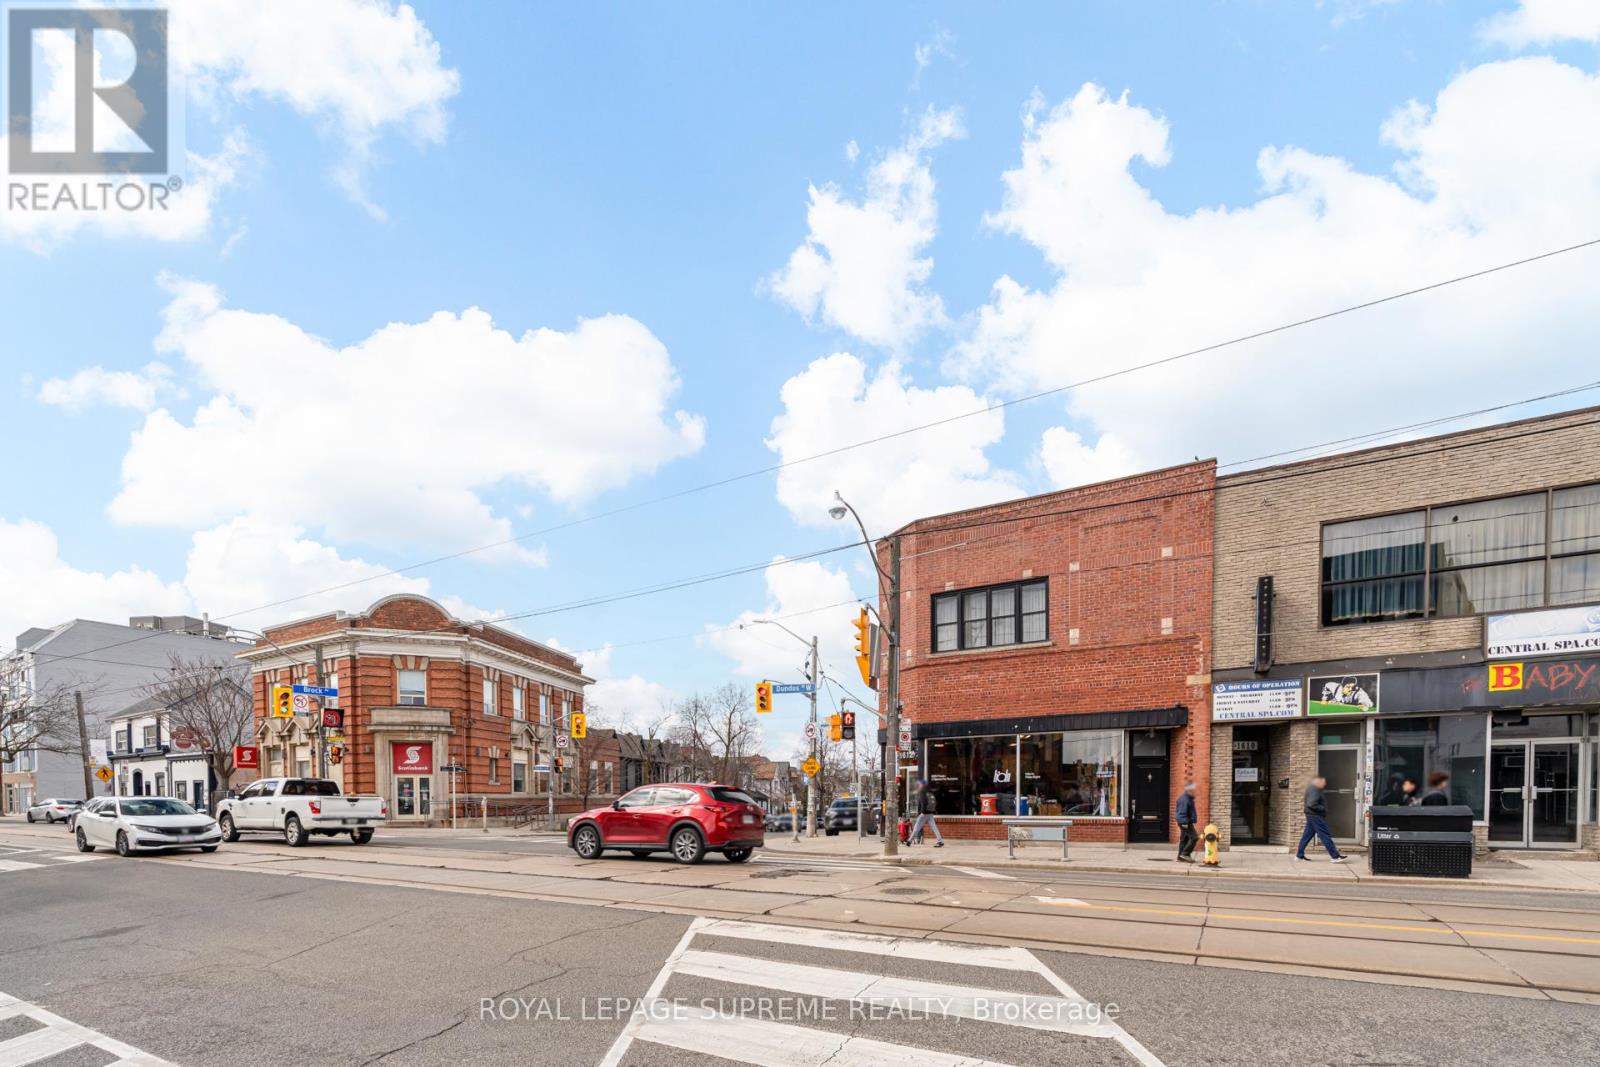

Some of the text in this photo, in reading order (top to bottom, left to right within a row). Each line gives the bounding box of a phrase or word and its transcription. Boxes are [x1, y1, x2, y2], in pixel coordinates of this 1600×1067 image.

[1488, 642, 1550, 656] CENTRAL
[303, 686, 323, 694] Brock
[1219, 710, 1294, 719] CENTRAL SPA.COM
